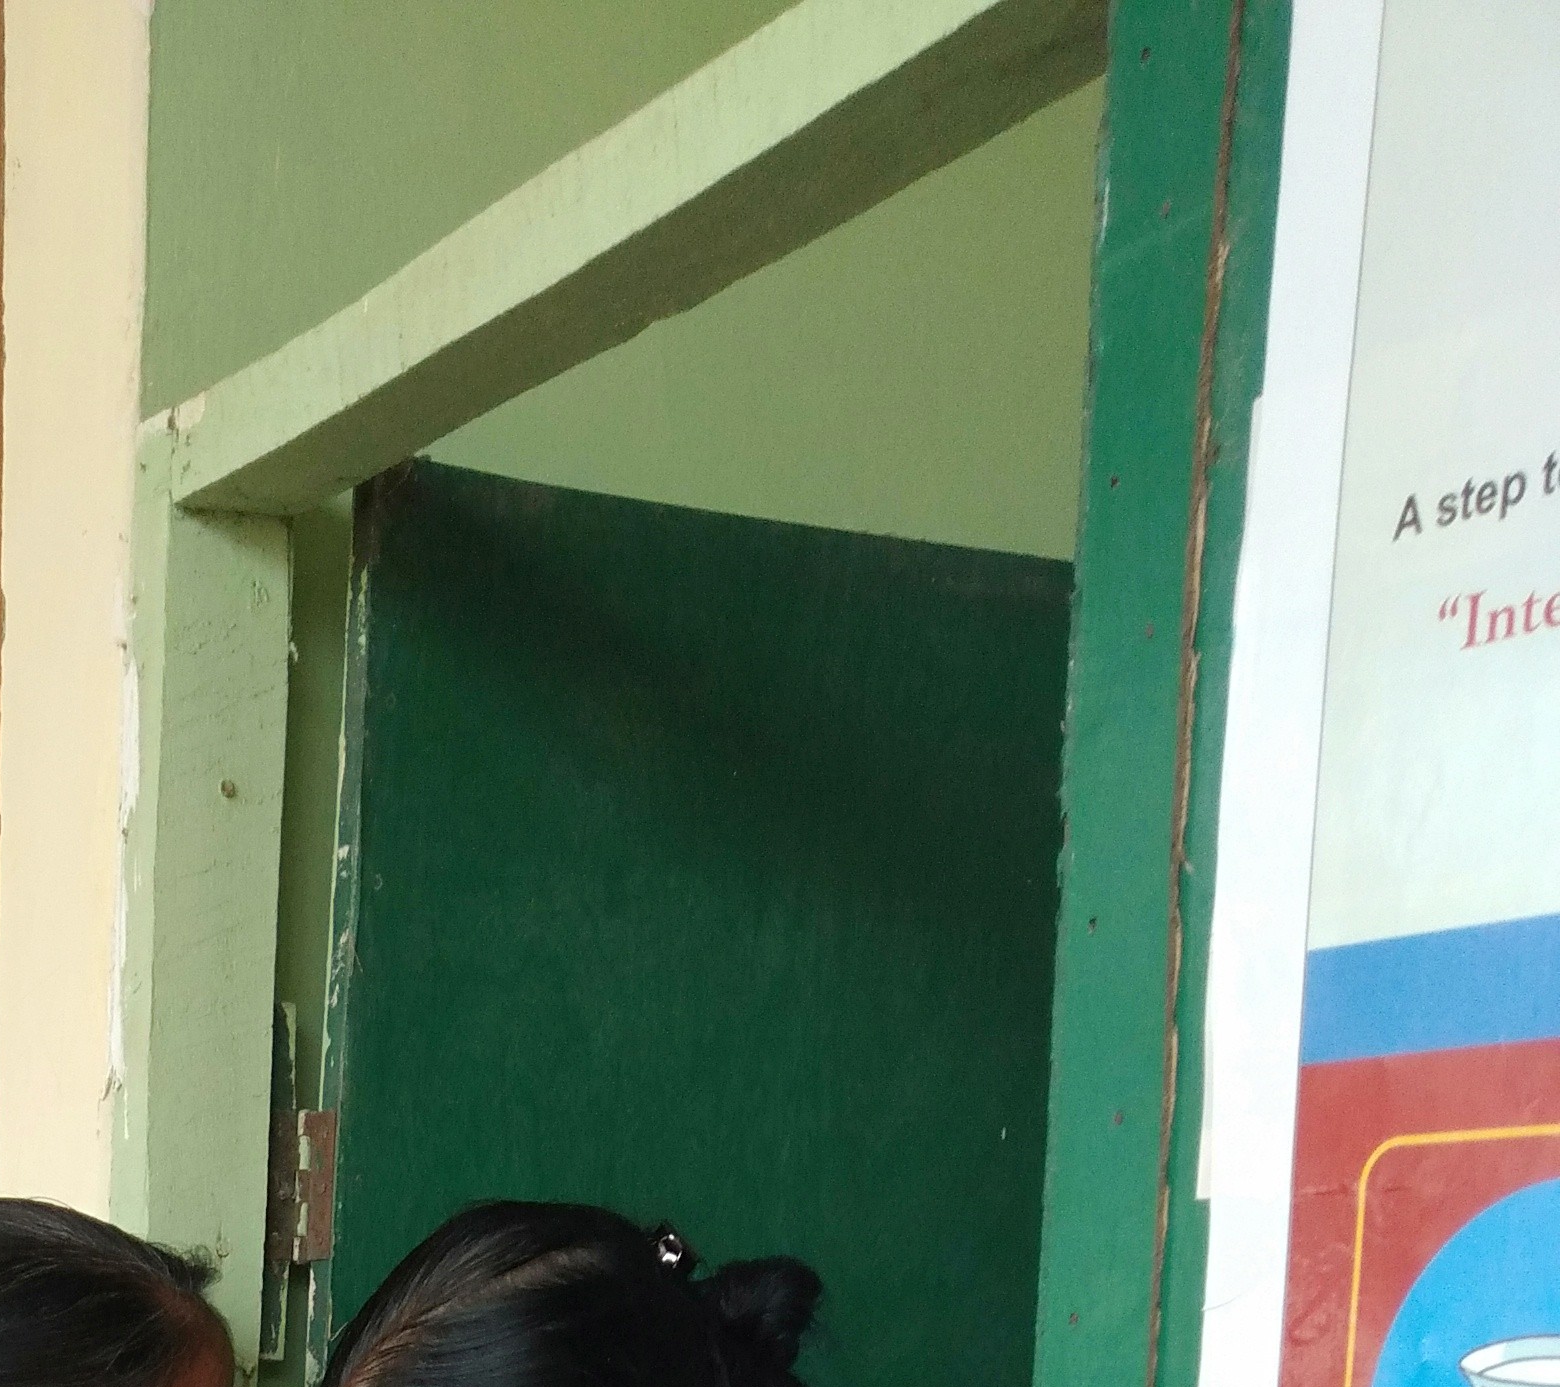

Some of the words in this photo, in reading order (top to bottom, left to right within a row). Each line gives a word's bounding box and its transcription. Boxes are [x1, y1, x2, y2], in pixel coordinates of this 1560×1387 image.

[1393, 492, 1423, 543] A
[1436, 471, 1528, 527] step
[1543, 450, 1560, 495] t
